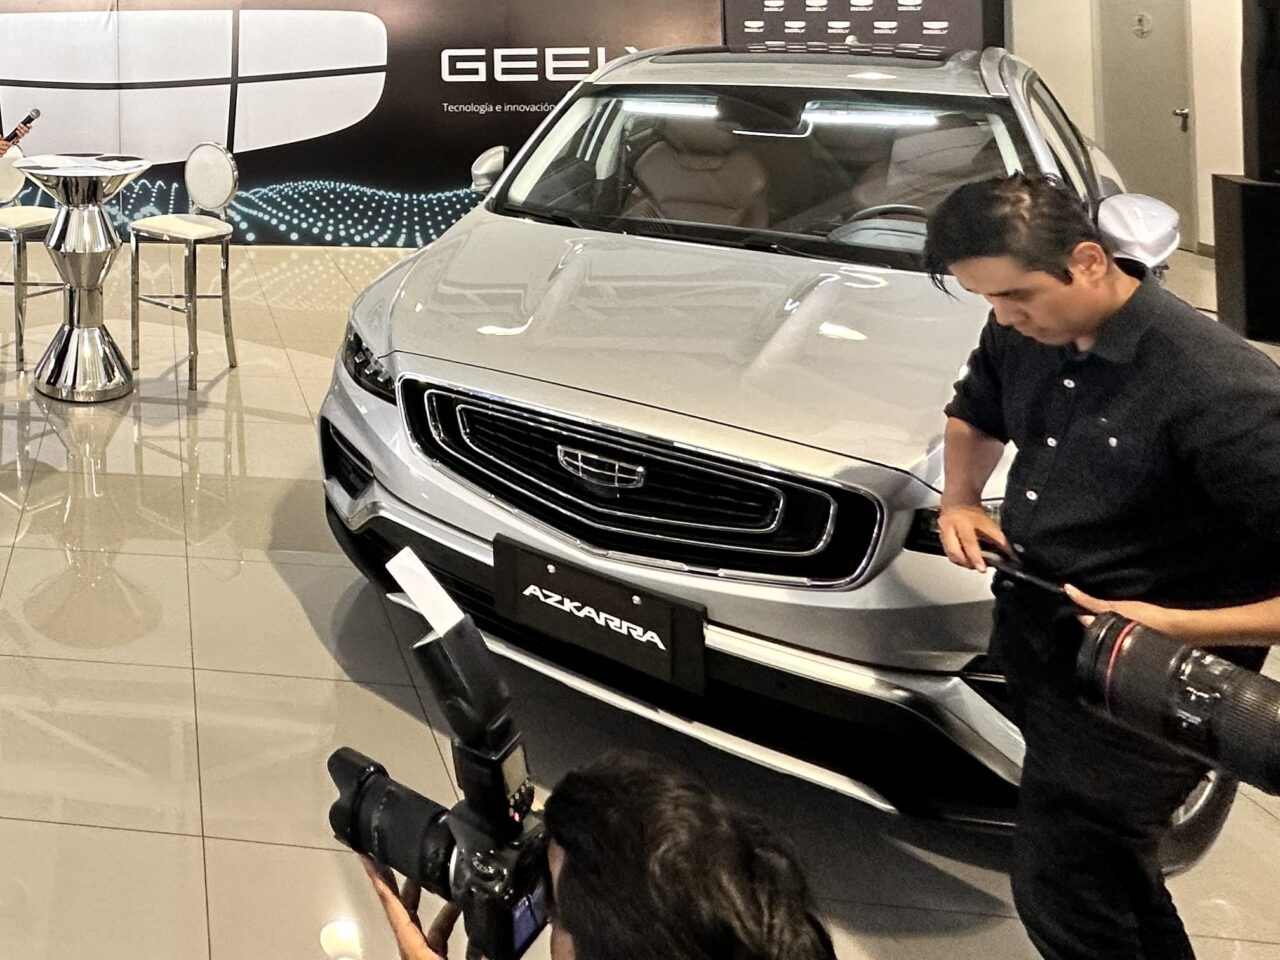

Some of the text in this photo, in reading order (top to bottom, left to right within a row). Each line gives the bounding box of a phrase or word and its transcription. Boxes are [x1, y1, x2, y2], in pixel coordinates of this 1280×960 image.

[440, 46, 640, 82] GEE
[442, 102, 493, 114] Tecnología
[495, 104, 502, 112] e
[522, 584, 667, 651] AZKARRA
